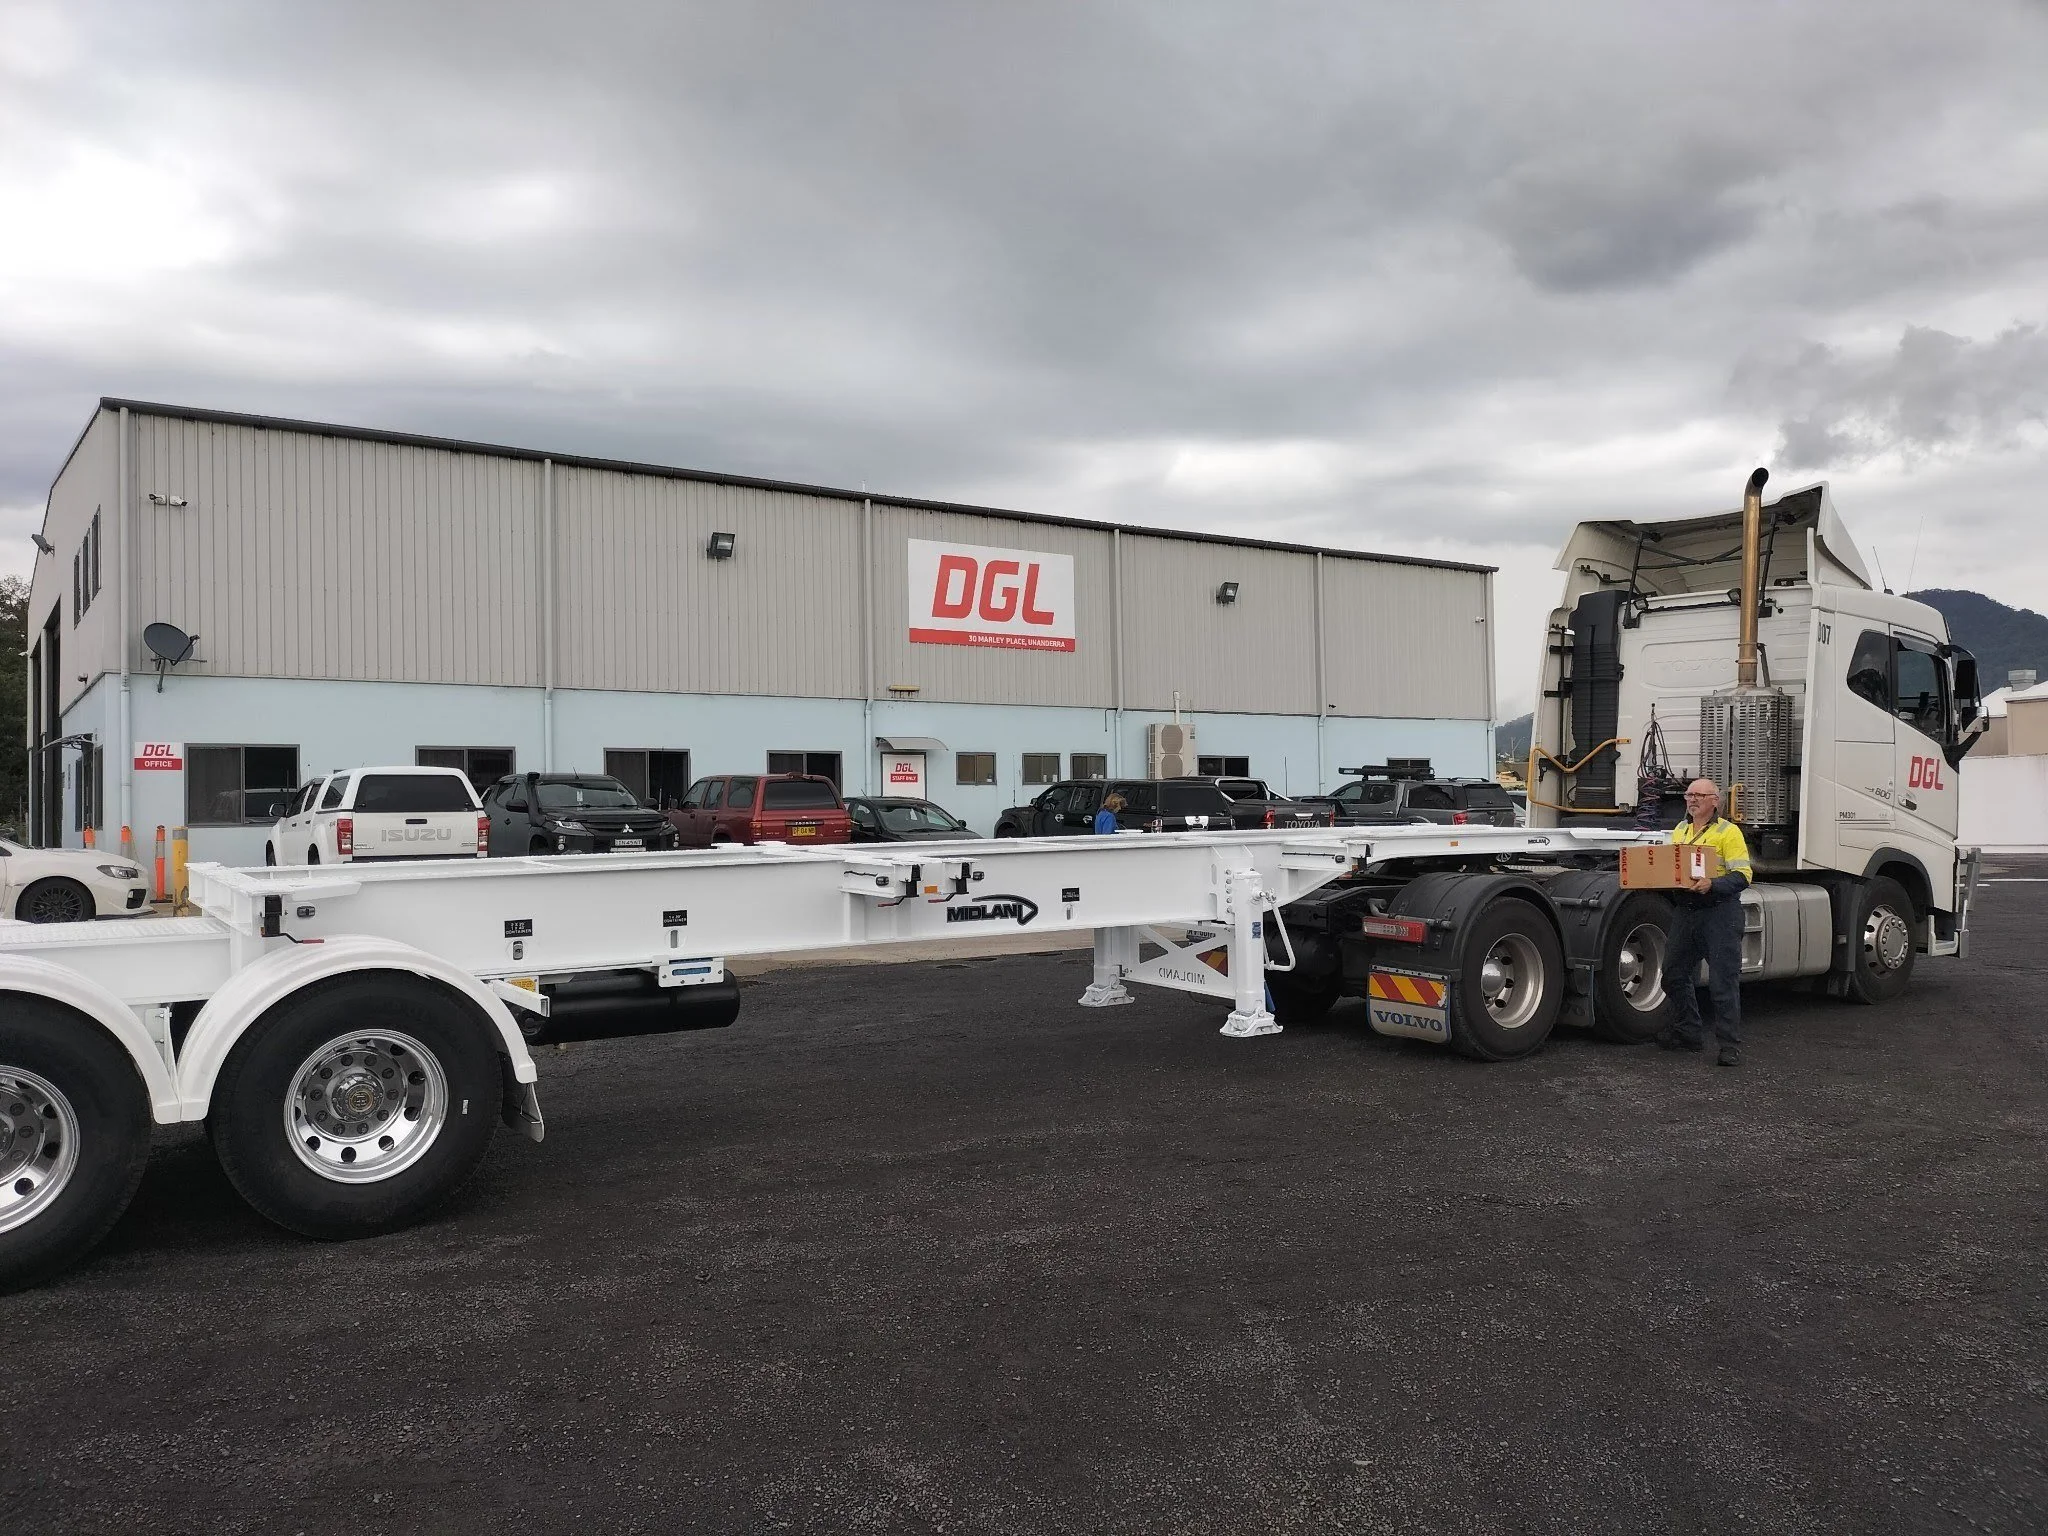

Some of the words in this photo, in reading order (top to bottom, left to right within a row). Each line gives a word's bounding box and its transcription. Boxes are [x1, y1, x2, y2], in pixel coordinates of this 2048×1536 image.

[932, 554, 1054, 625] DGL
[978, 635, 1004, 644] MARLEY
[1005, 637, 1027, 646] PLACE,
[142, 744, 174, 756] DGL
[144, 760, 173, 768] OFFICE
[895, 762, 914, 772] DGL
[1908, 756, 1944, 790] DGL
[1874, 787, 1891, 800] 600
[1284, 820, 1321, 828] TOYOTA
[381, 828, 452, 842] ISUZU
[947, 894, 1038, 926] MIDLAND
[1373, 1009, 1443, 1032] VOLVO
